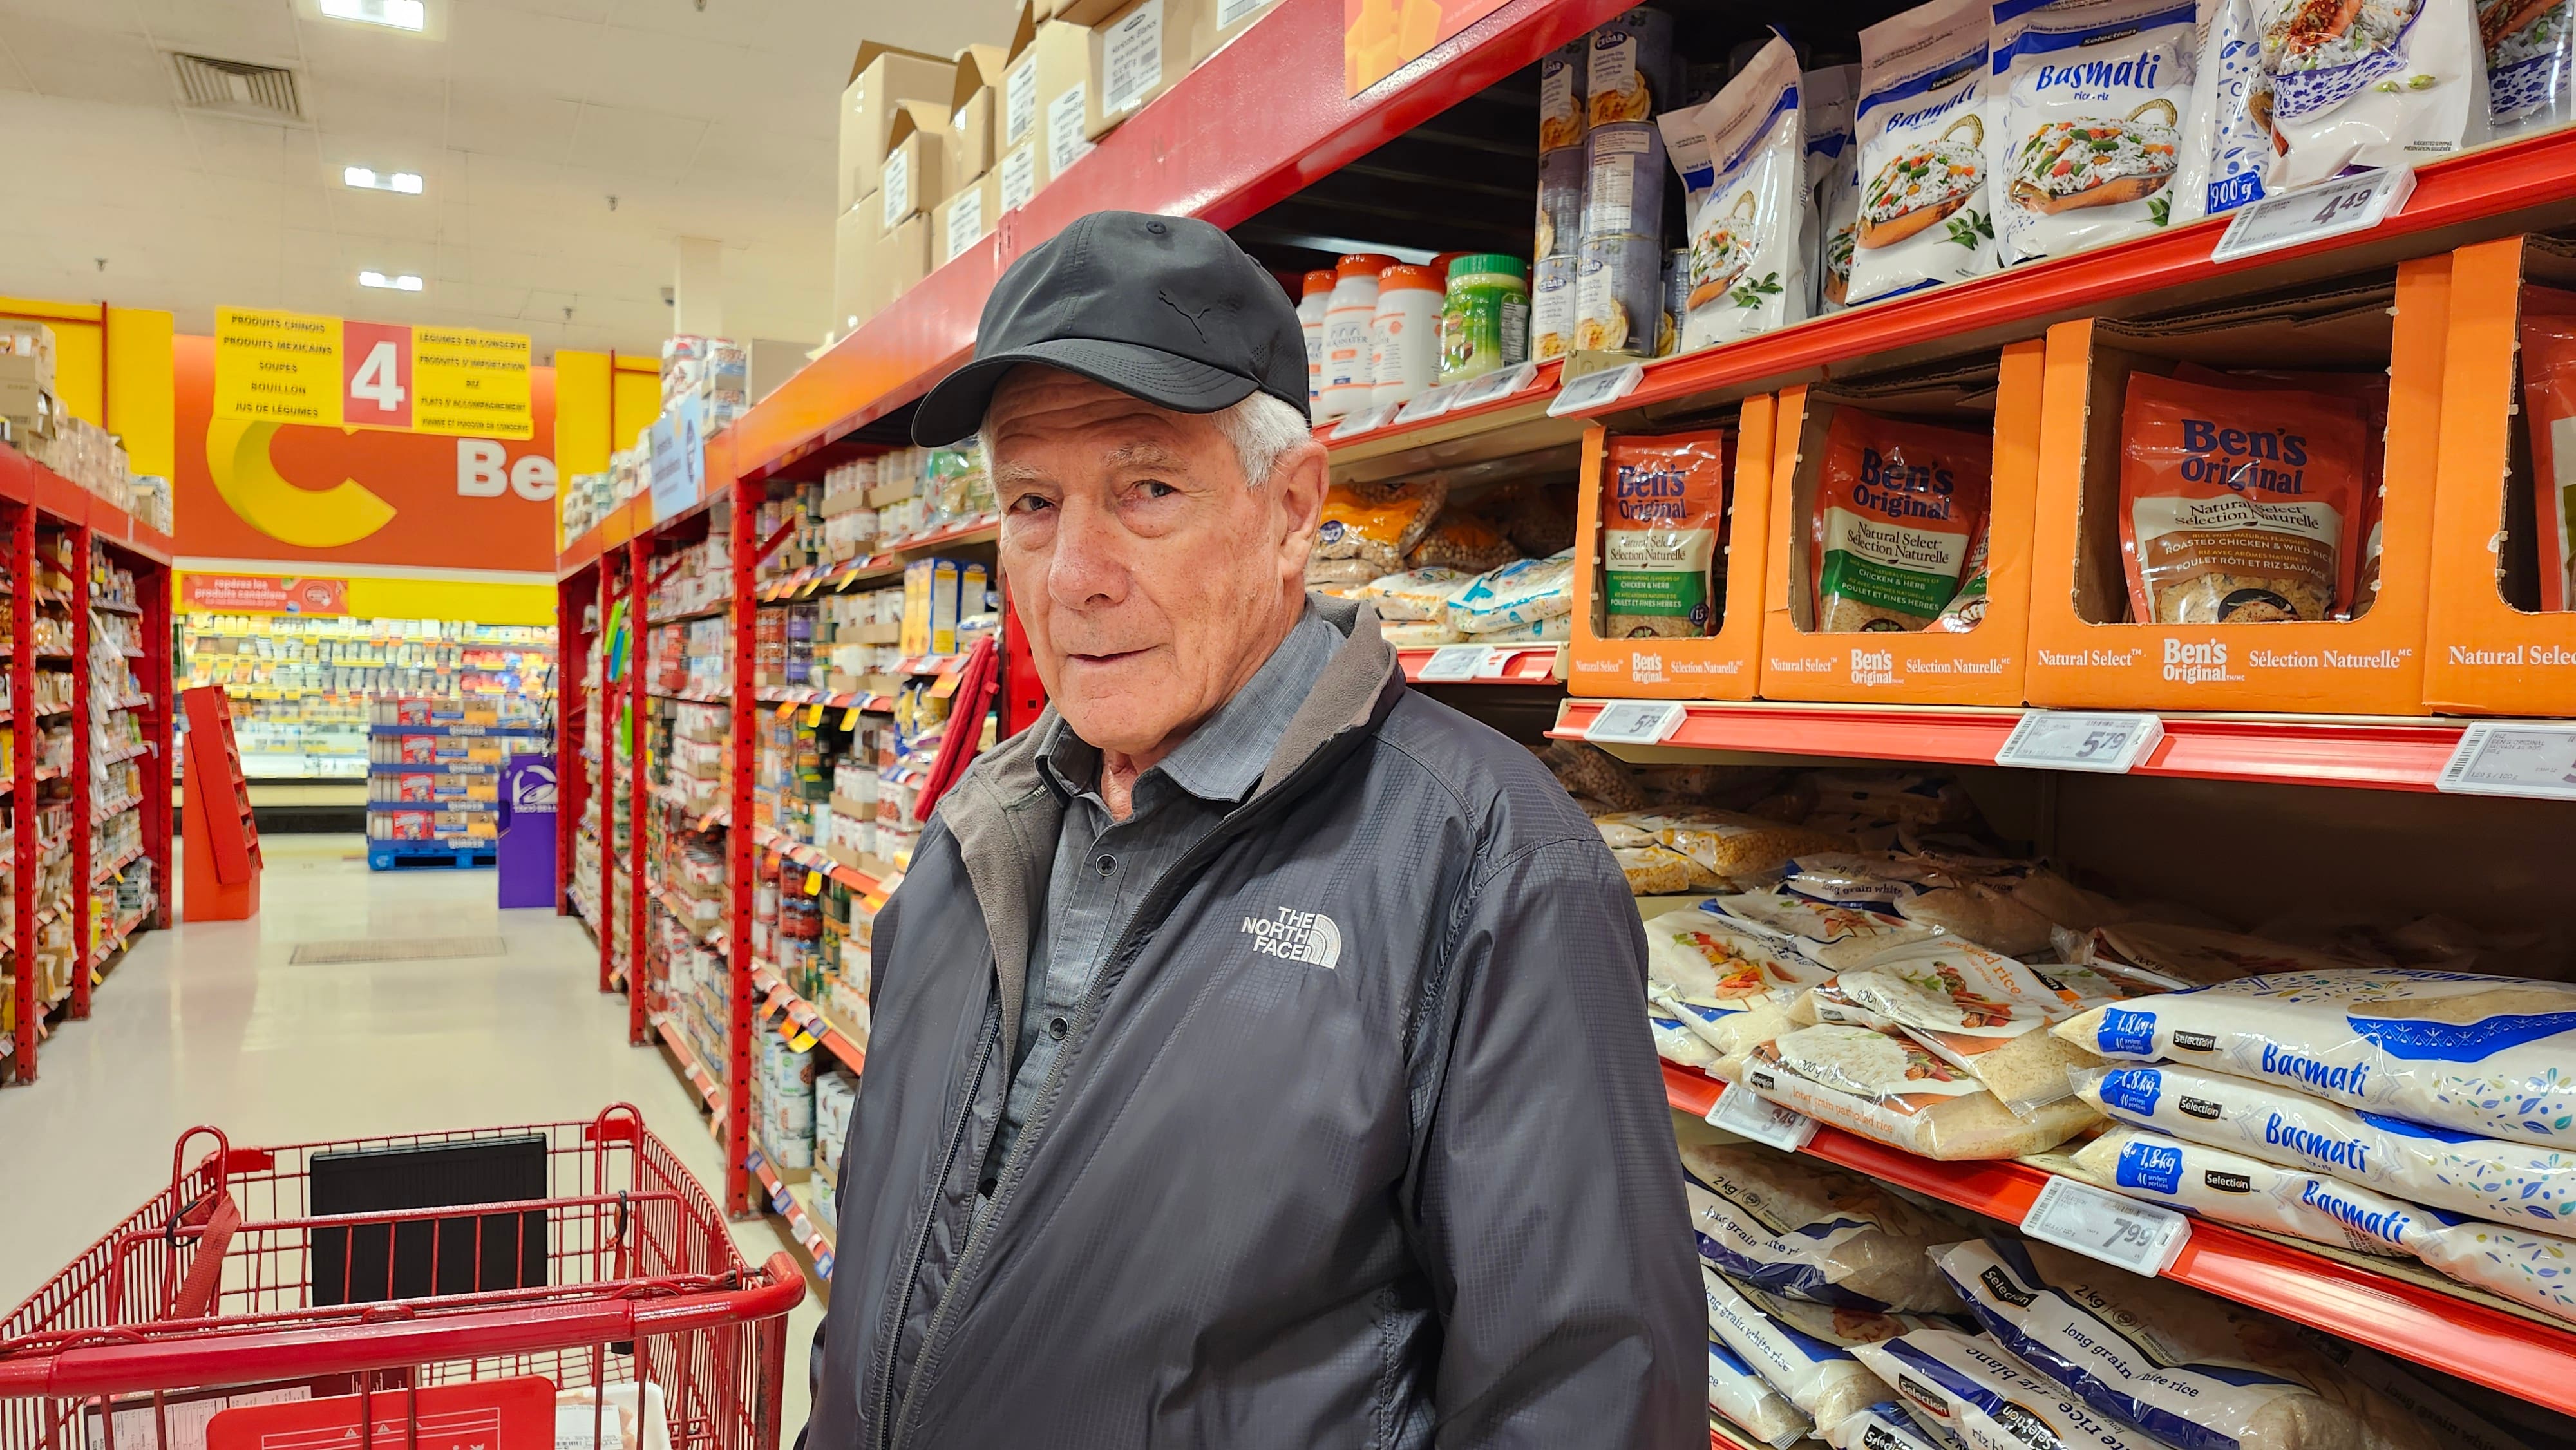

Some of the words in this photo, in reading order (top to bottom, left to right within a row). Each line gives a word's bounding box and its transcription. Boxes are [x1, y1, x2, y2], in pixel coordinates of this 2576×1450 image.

[2036, 50, 2161, 91] Basmati
[1885, 79, 1980, 134] Basmati
[2211, 180, 2238, 209] 900
[232, 314, 281, 328] PRODUITS
[284, 321, 325, 334] CHINOIS
[223, 335, 274, 349] PRODUITS
[277, 341, 332, 355] MEXICAINS
[259, 361, 298, 373] SOUPES
[350, 340, 406, 412] 4
[251, 382, 307, 395] BOUILLON
[236, 401, 252, 411] JUS
[256, 404, 269, 413] DE
[272, 402, 319, 418] LÉGUMES
[2181, 419, 2307, 467] Ben's
[1860, 447, 1955, 495] Ben's
[2180, 457, 2304, 495] Original
[1617, 464, 1686, 499] Ben's
[1618, 498, 1687, 523] Original
[1853, 484, 1951, 521] Original
[2190, 500, 2252, 516] Natural
[2175, 511, 2248, 525] Sélection
[1857, 521, 1900, 544] Natural
[2234, 532, 2268, 541] NATURAL
[1847, 530, 1893, 557] Sélection
[2165, 538, 2215, 555] ROASTED
[2219, 538, 2270, 550] CHICKEN
[2283, 543, 2311, 555] WILD
[1610, 548, 1644, 562] Sélection
[1859, 568, 1893, 585] CHICKEN
[1903, 580, 1926, 590] HERB
[2176, 556, 2217, 572] POULET
[2220, 556, 2245, 567] RÔTI
[2248, 559, 2260, 567] ET
[2264, 560, 2281, 569] RIZ
[2283, 562, 2327, 583] SAUVAGE
[1653, 581, 1670, 590] HERB
[1610, 599, 1631, 607] POULET
[1657, 600, 1682, 608] HERBES
[1842, 583, 1871, 596] POULET
[1883, 594, 1906, 605] FINES
[1908, 598, 1939, 611] HERBES
[1632, 652, 1662, 671] Ben's
[1851, 648, 1893, 670] Ben's
[2038, 650, 2088, 666] Natural
[2164, 638, 2227, 665] Ben's
[2249, 651, 2319, 668] Sélection
[2448, 645, 2524, 666] Natural
[1576, 660, 1599, 672] Natural
[1671, 661, 1703, 673] Sélection
[1770, 658, 1803, 672] Natural
[1906, 659, 1951, 673] Sélection
[2163, 664, 2226, 684] Original
[1633, 670, 1662, 684] Original
[1851, 670, 1893, 687] Original
[1278, 906, 1316, 928] THE
[1241, 916, 1310, 944] NORTH
[1253, 936, 1305, 961] FACE
[1993, 965, 2022, 995] rice
[2115, 1037, 2124, 1050] 40
[2174, 1033, 2213, 1049] Selection
[2261, 1042, 2371, 1098] Basmati
[2119, 1093, 2128, 1107] 40
[2180, 1098, 2219, 1117] Selection
[1875, 1118, 1893, 1134] rice
[2265, 1111, 2371, 1174] Basmati
[2157, 1151, 2176, 1175] kg
[1712, 1176, 1725, 1185] 2
[1721, 1180, 1738, 1196] kg
[2137, 1172, 2147, 1186] 40
[2148, 1174, 2167, 1183] servings
[2148, 1180, 2168, 1190] portions
[2206, 1173, 2249, 1191] Selection
[2302, 1178, 2411, 1245] Basmati
[1725, 1221, 1757, 1247] grain
[2074, 1284, 2085, 1297] 2
[2086, 1291, 2107, 1310] kg
[1719, 1307, 1745, 1332] grain
[1745, 1328, 1772, 1355] white
[2062, 1322, 2094, 1348] long
[2091, 1345, 2133, 1380] grain
[2168, 1379, 2199, 1397] rice
[1900, 1380, 1947, 1415] Selection
[2058, 1401, 2096, 1436] rice
[1971, 1427, 1989, 1446] riz
